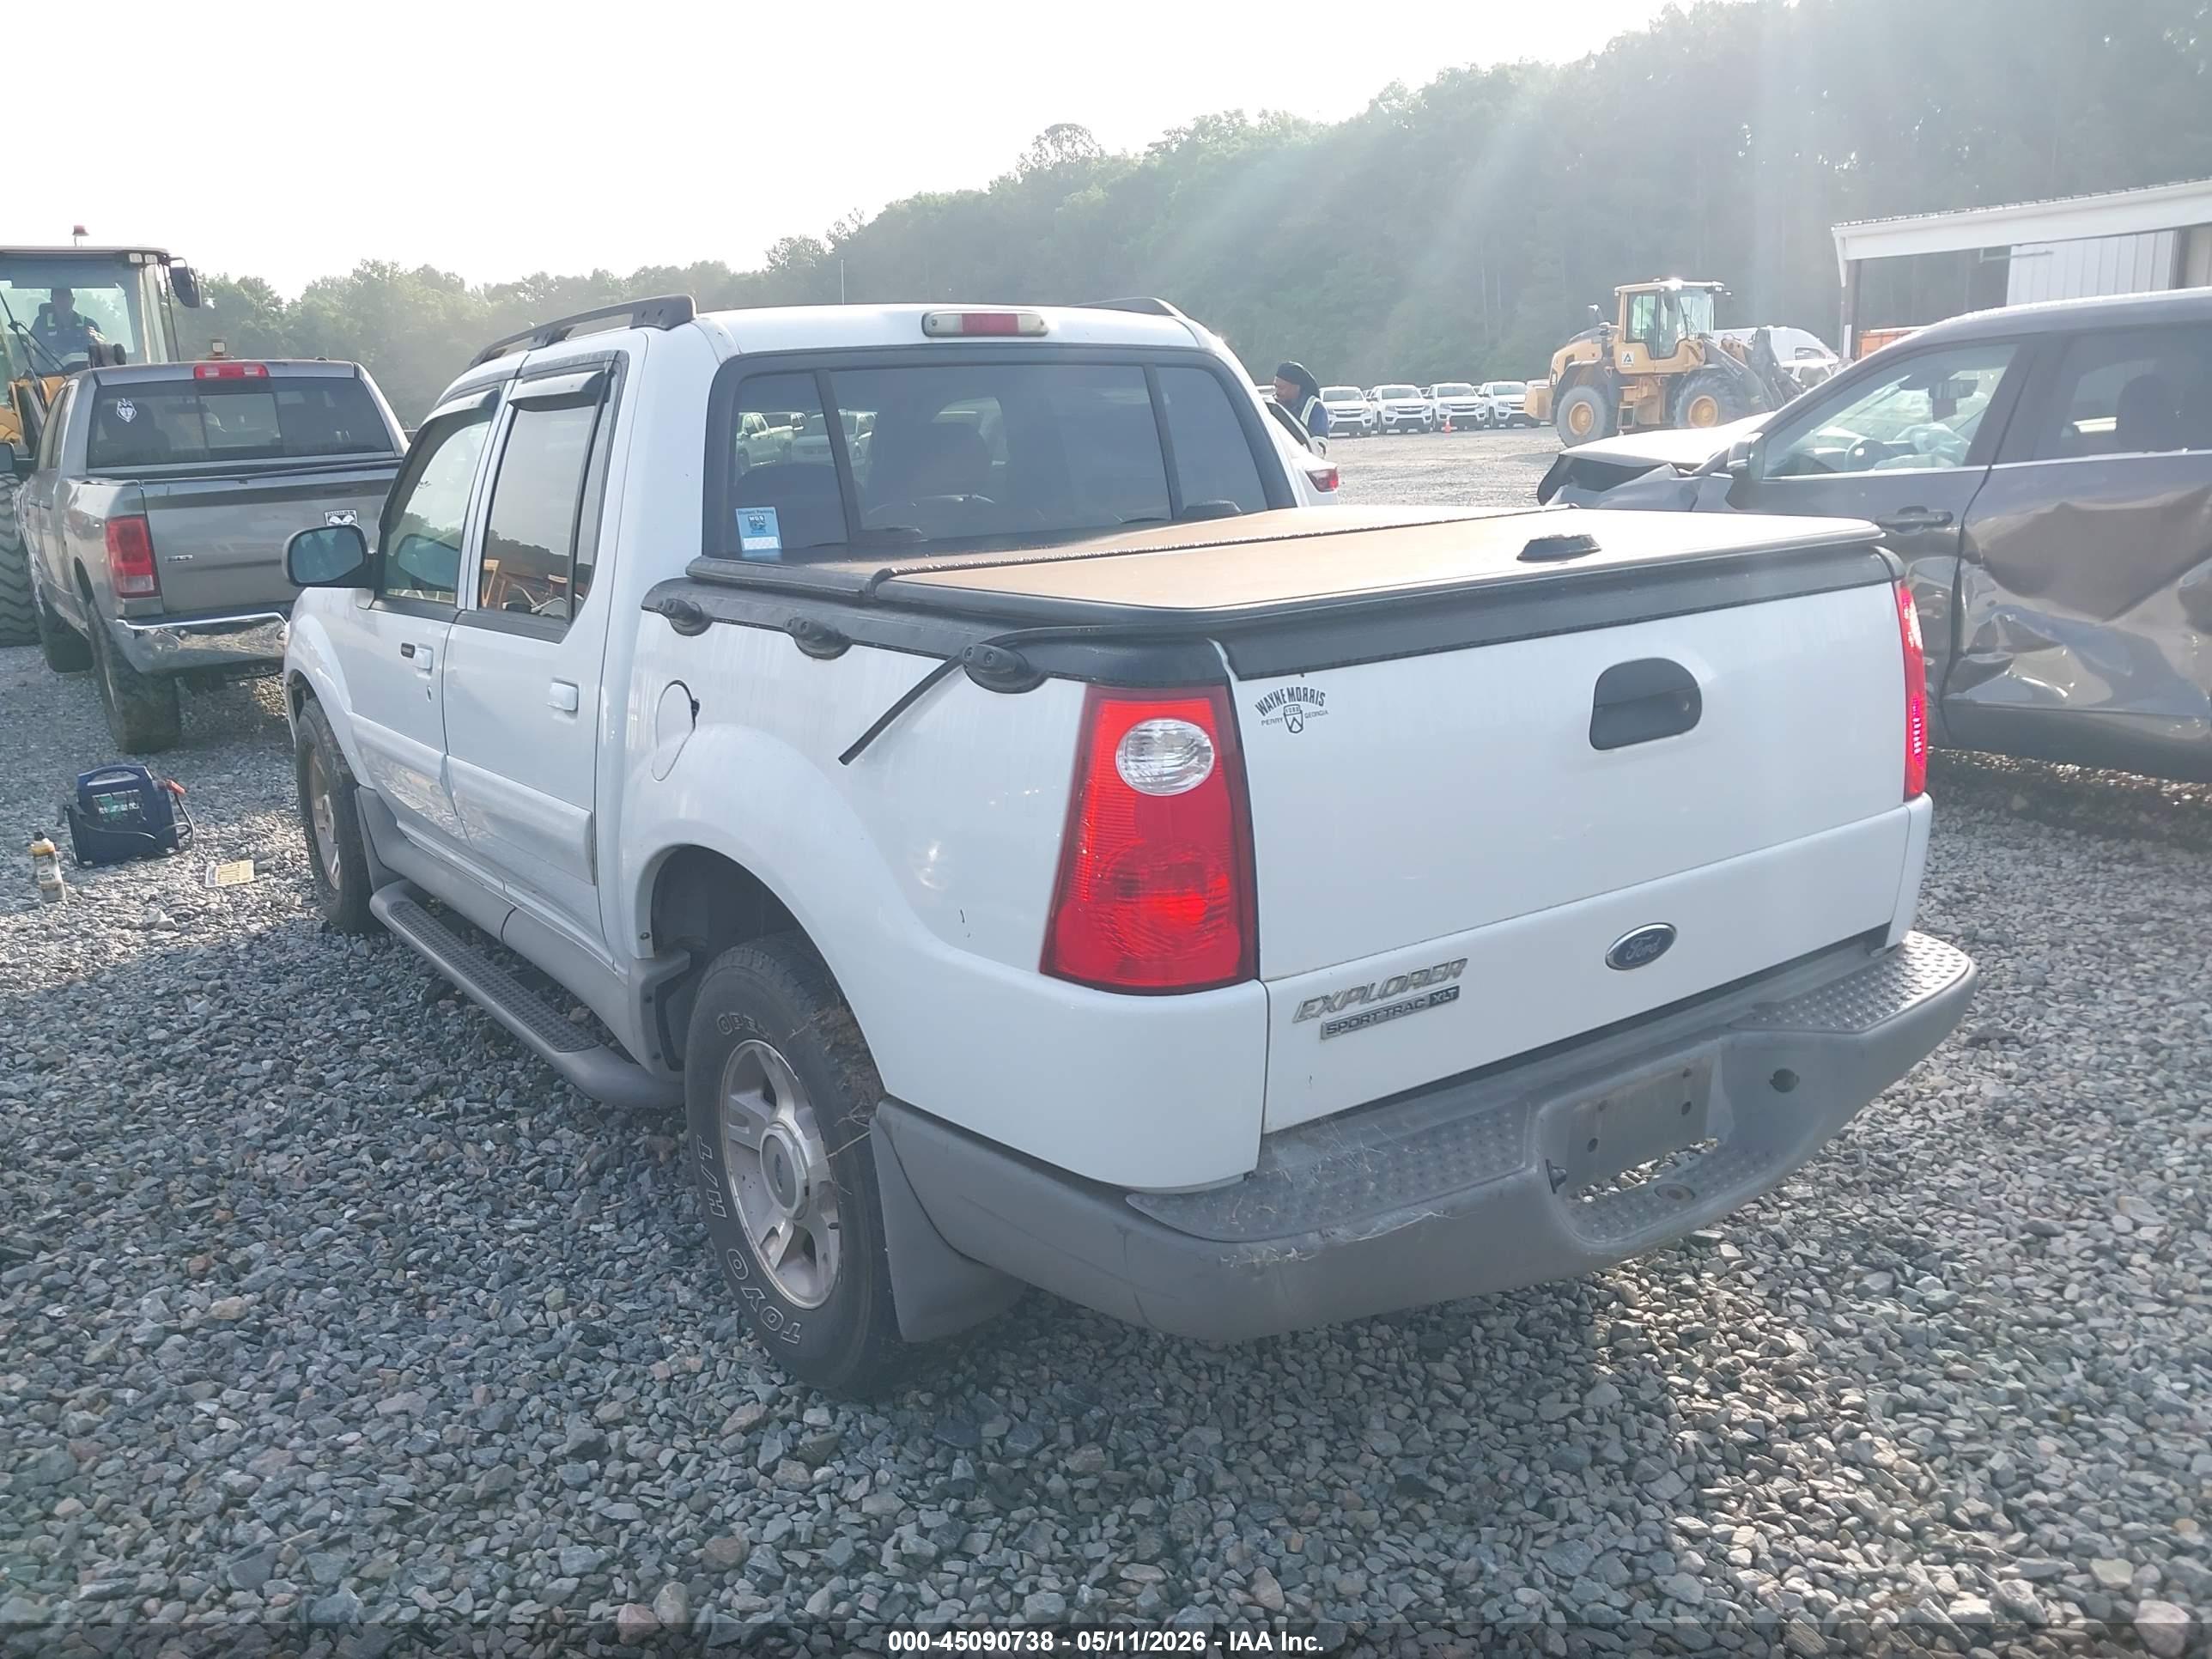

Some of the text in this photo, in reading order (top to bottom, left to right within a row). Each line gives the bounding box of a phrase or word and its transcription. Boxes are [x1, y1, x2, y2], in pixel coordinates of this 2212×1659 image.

[1255, 686, 1326, 716] WAYNE MORRIS
[1261, 717, 1284, 726] PERRY
[1626, 933, 1662, 961] Ford
[1291, 957, 1468, 1024] EXPLORER
[1326, 988, 1457, 1036] SPORT TRAC XLT
[726, 1249, 801, 1345] TOYO
